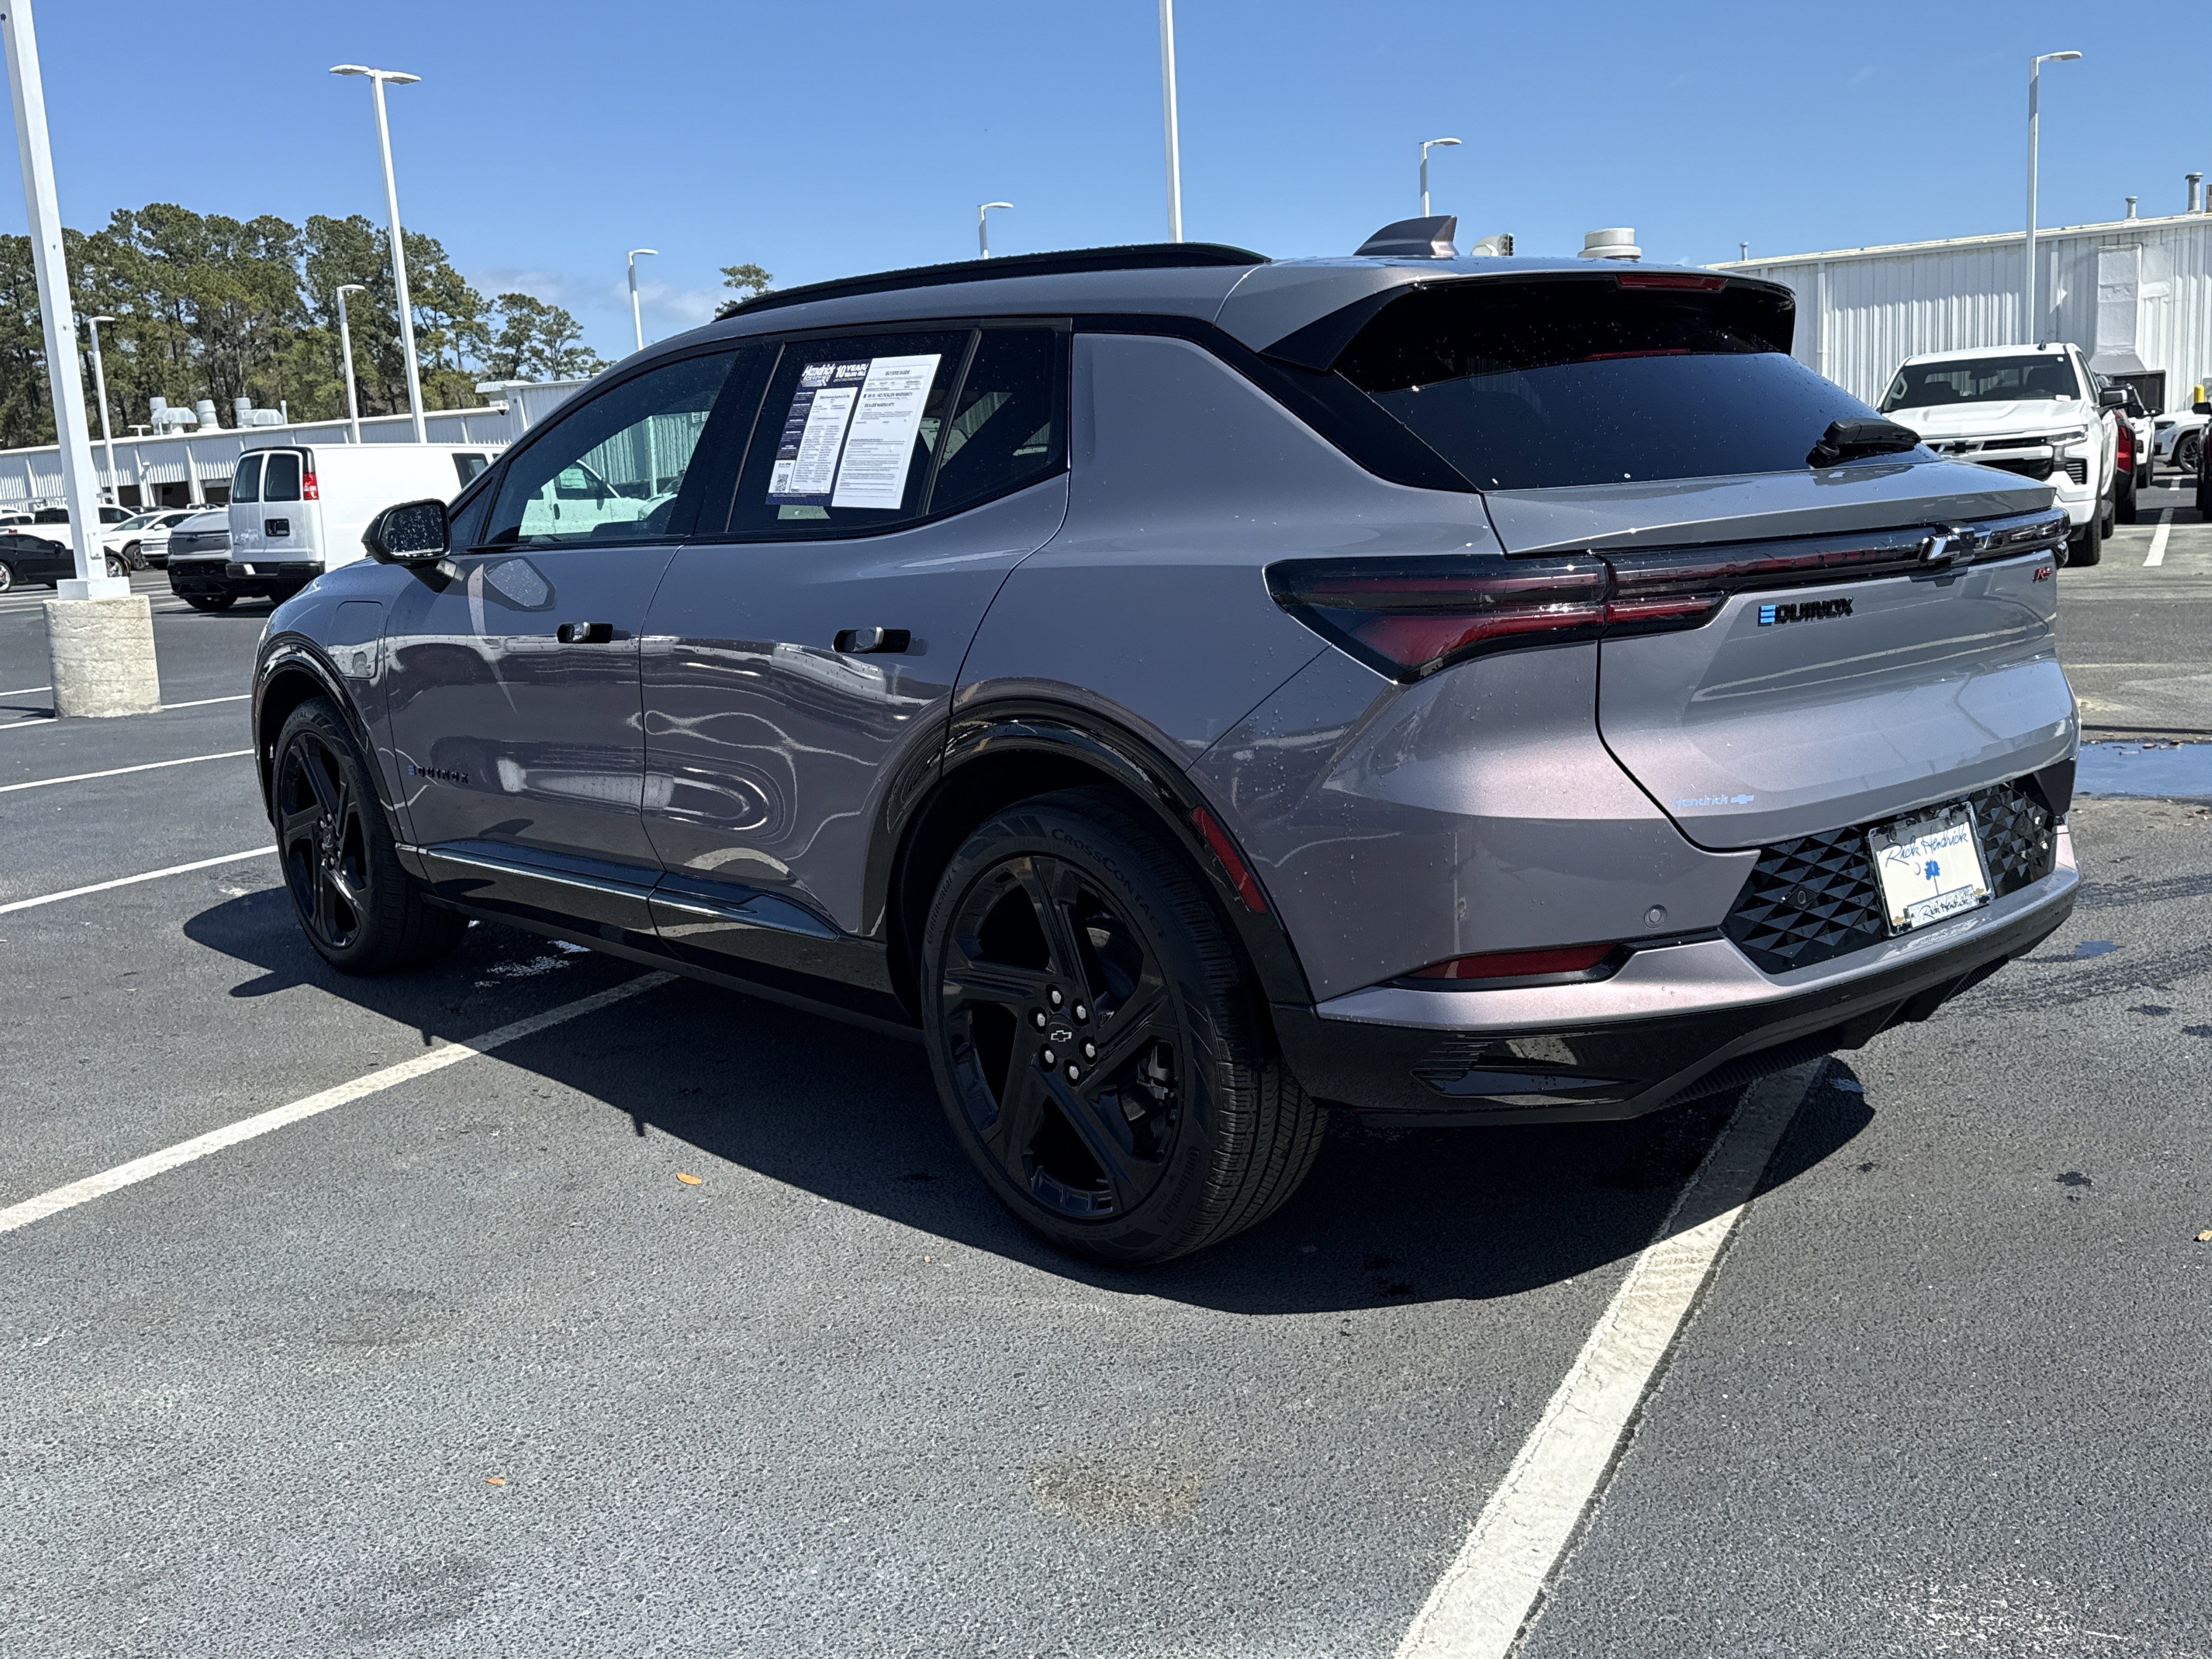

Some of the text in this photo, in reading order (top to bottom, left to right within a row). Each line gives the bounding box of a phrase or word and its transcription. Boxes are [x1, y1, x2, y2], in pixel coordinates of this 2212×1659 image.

[836, 365, 847, 378] 10
[1758, 596, 1854, 626] EQUINOX
[1672, 794, 1729, 811] Hendrick
